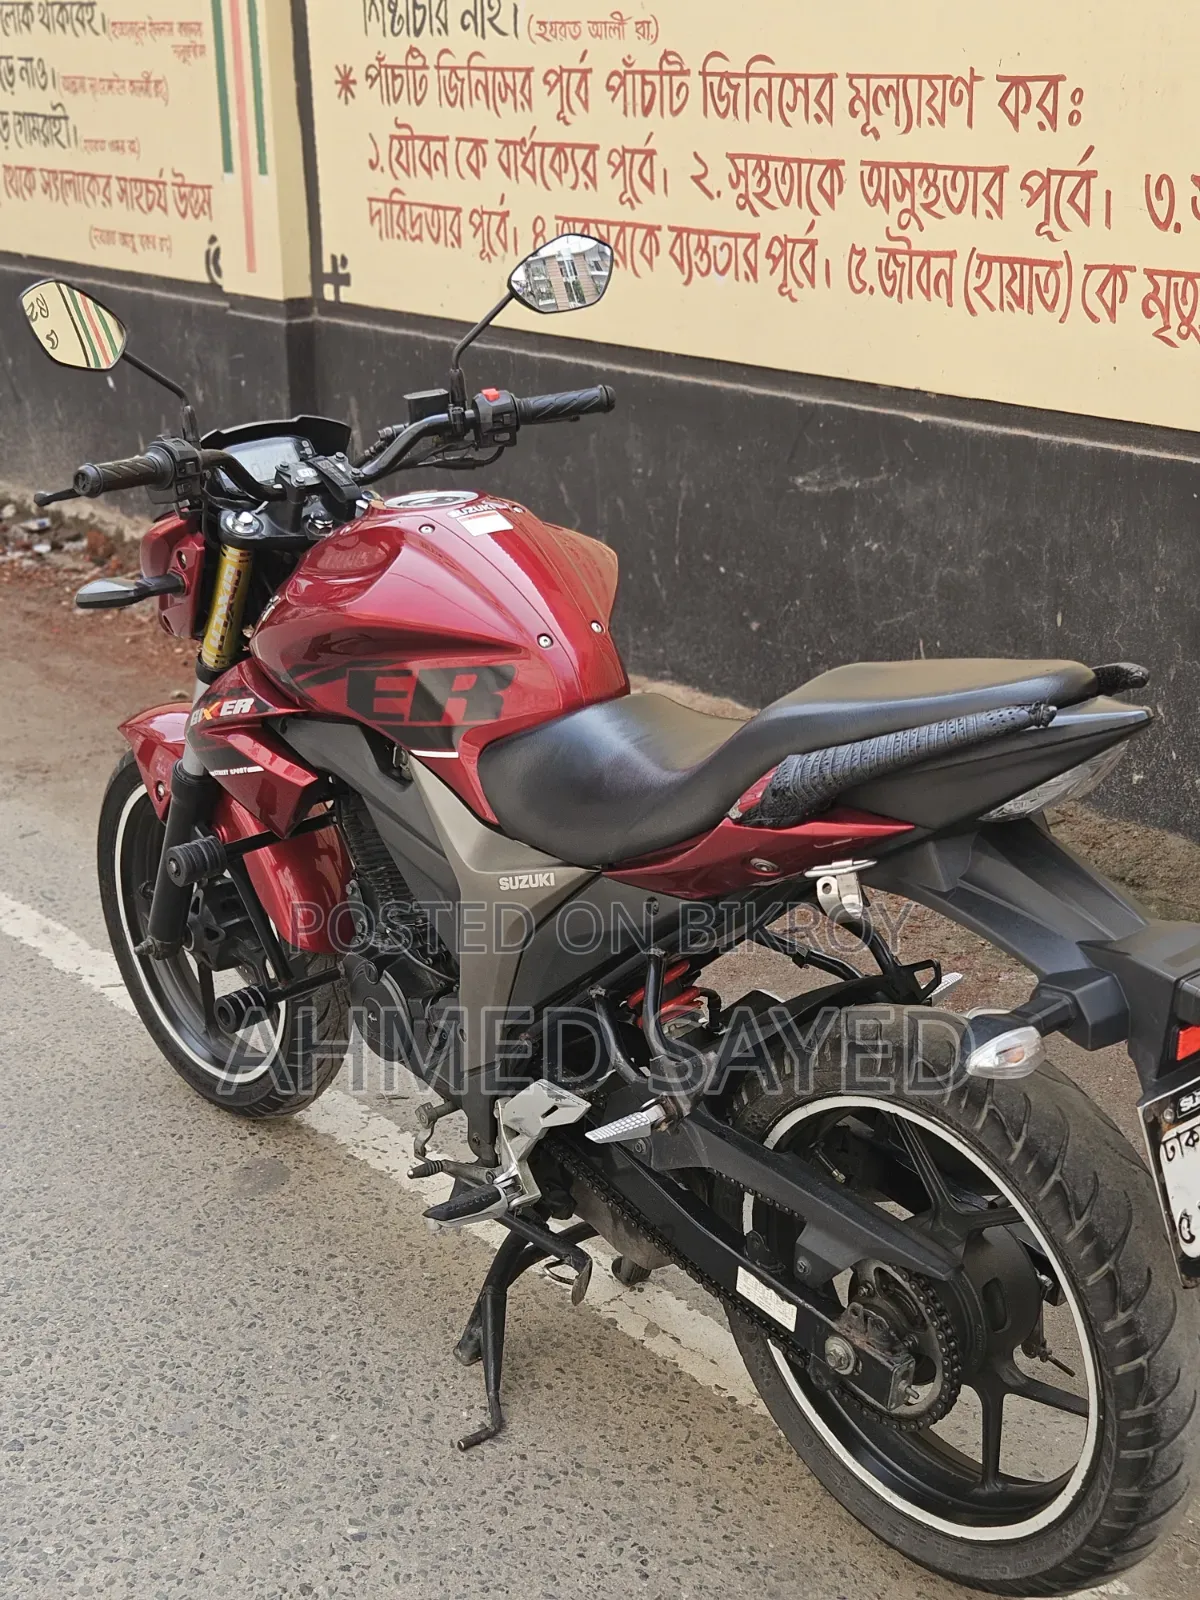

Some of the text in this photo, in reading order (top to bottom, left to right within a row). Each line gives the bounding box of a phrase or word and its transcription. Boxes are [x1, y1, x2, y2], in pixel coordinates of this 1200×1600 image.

[527, 14, 582, 45] (হযরত
[587, 11, 633, 41] আলী
[365, 45, 430, 107] পাঁচটি
[434, 48, 535, 119] জিনিসের
[542, 49, 593, 126] পূর্বে
[605, 49, 691, 119] পাঁচটি
[698, 51, 838, 128] জিনিসের
[115, 168, 168, 215] সাহচর্য
[171, 167, 213, 221] উত্তম
[455, 136, 489, 180] কে
[495, 125, 600, 192] বার্ধক্যের
[725, 151, 846, 218] সুস্থতাকে
[860, 159, 1010, 232] অসুস্থতার
[667, 225, 761, 286] ব্যস্ততার
[963, 247, 1073, 324] (হায়াত)
[1081, 264, 1137, 324] কে
[498, 872, 556, 891] SUZUKI
